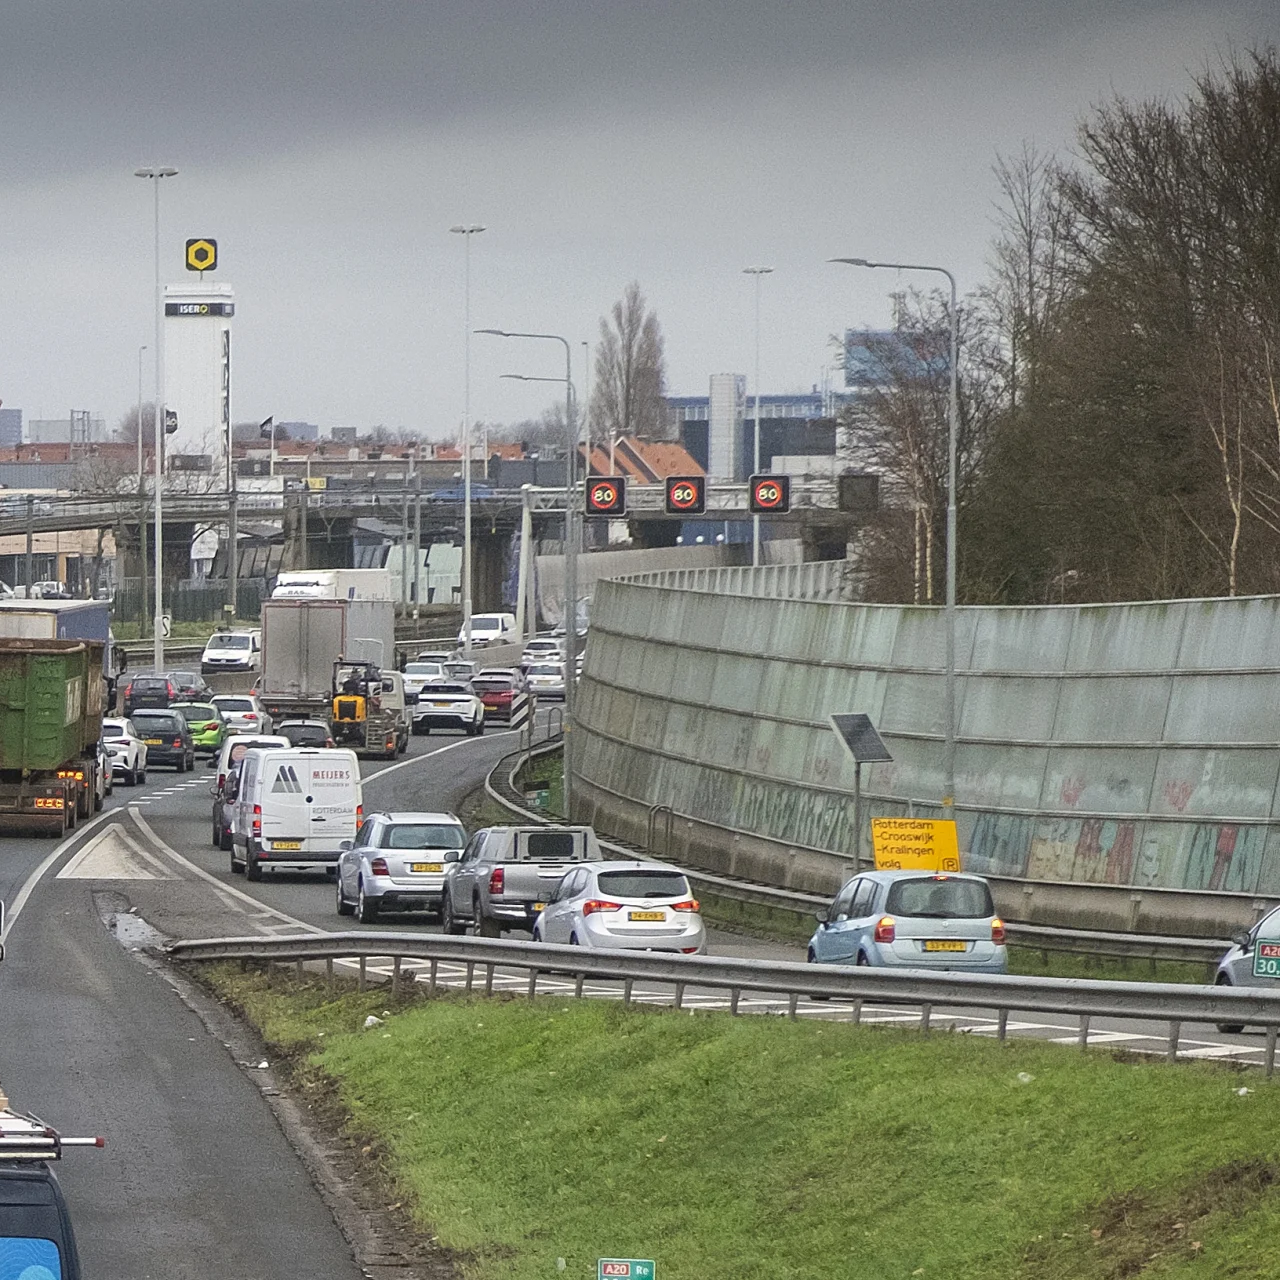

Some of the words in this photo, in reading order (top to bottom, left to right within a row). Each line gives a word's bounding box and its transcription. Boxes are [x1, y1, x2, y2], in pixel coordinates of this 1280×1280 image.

[594, 489, 614, 501] 80
[673, 488, 694, 501] 80
[758, 487, 778, 500] 80
[312, 770, 350, 779] MEIJERS
[873, 819, 934, 830] Rotterdam
[878, 860, 901, 869] volg
[605, 1264, 628, 1275] A20
[635, 1265, 650, 1276] Re
